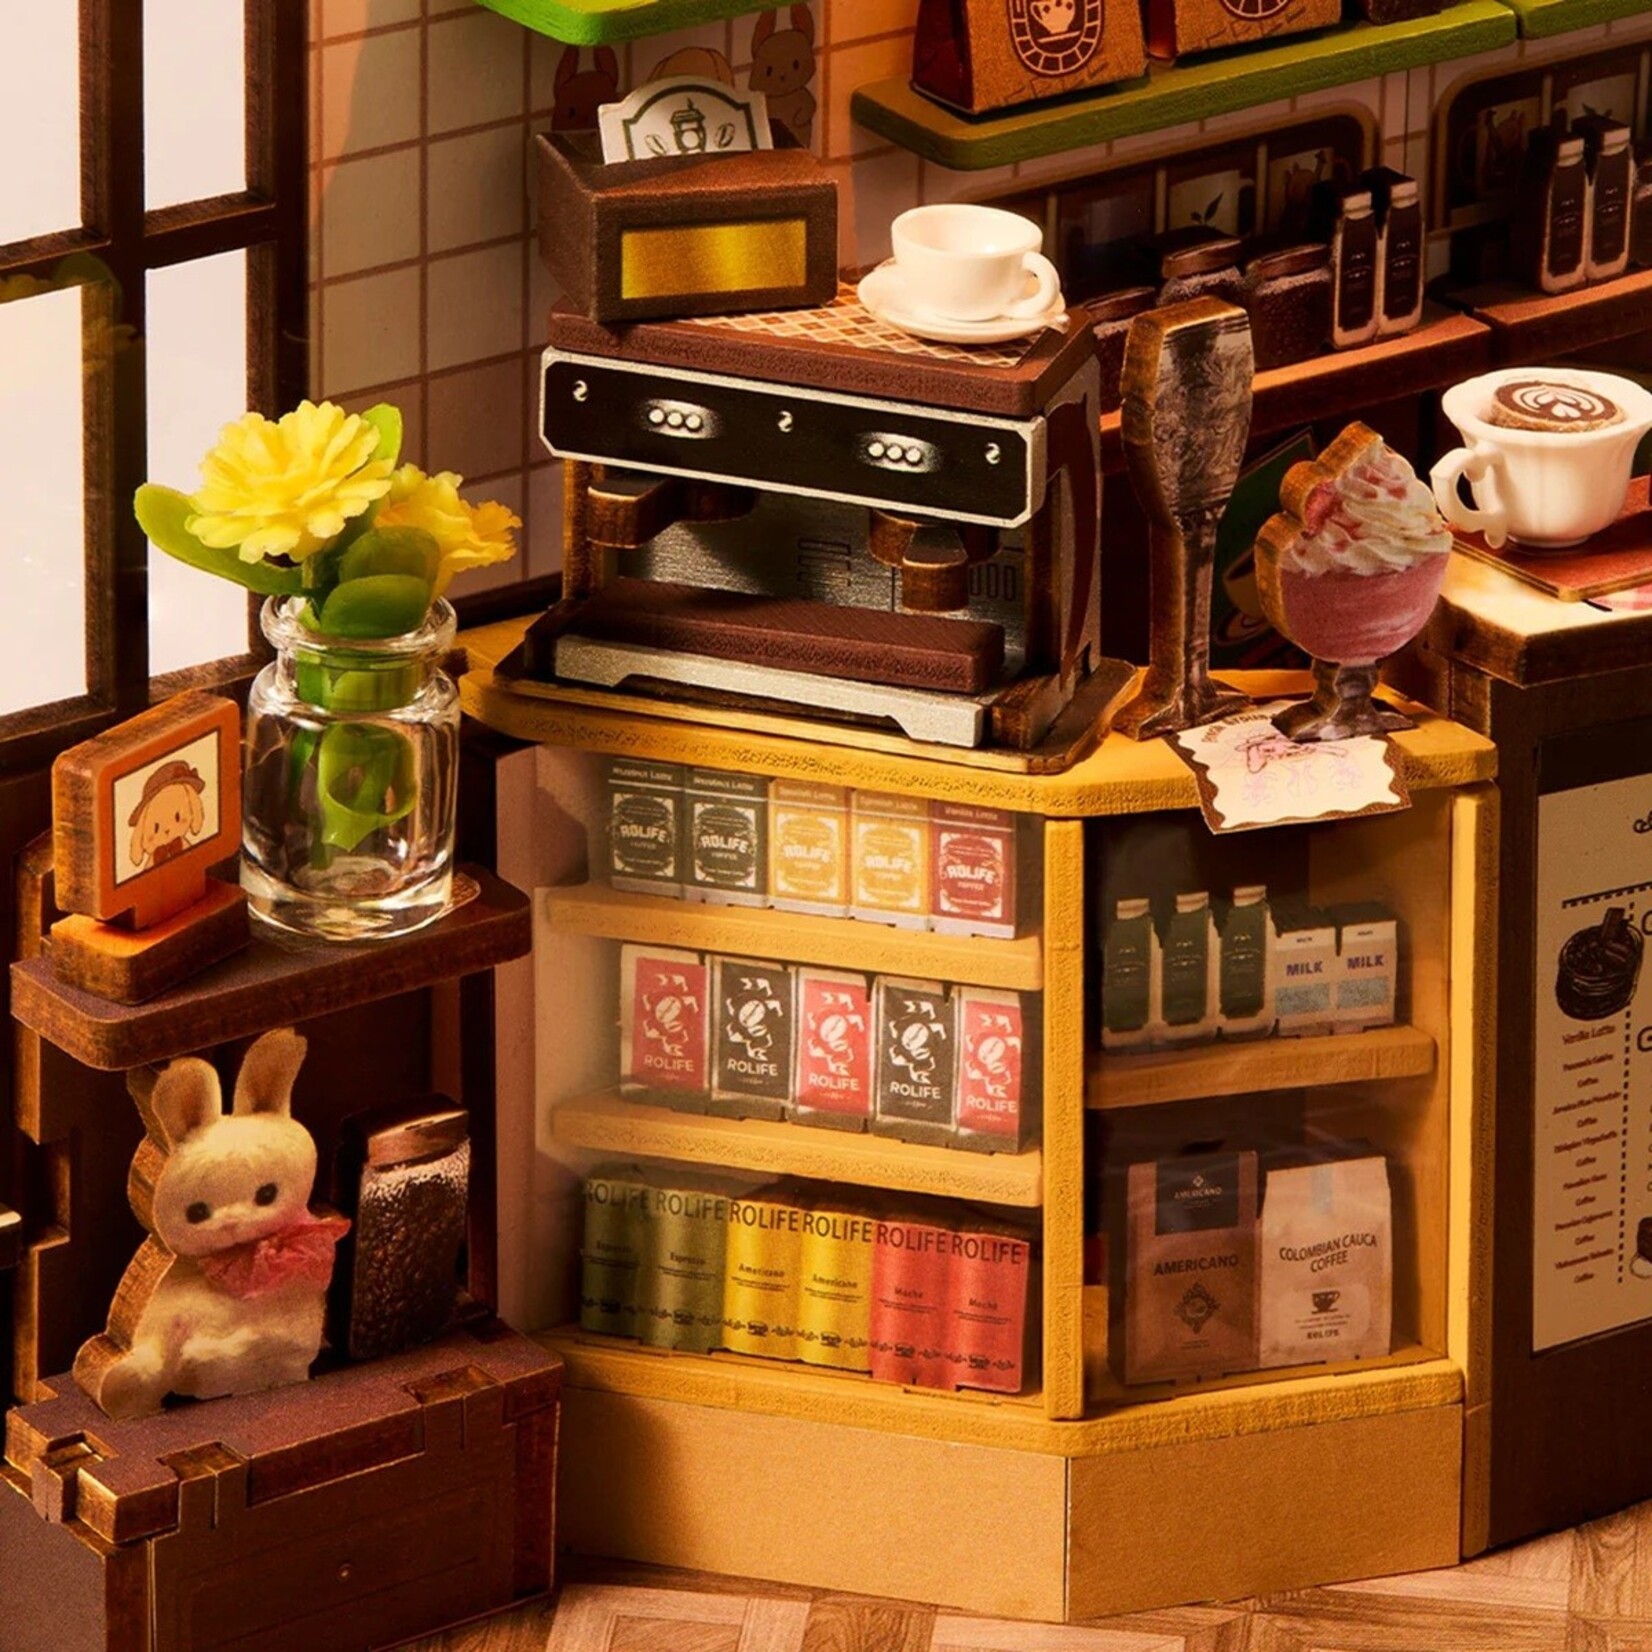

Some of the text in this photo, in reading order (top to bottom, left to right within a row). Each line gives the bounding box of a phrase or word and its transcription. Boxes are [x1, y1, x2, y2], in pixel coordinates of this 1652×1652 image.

[619, 824, 667, 842] ROLIFE
[701, 834, 750, 853] ROLIFE
[783, 844, 831, 864] ROLIFE
[864, 855, 913, 874] ROLIFE
[946, 864, 996, 885] ROLIFE
[1286, 960, 1323, 977] MILK
[1347, 954, 1384, 970] MILK
[644, 1053, 694, 1073] ROLIFE
[727, 1057, 778, 1077] ROLIFE
[808, 1072, 860, 1092] ROLIFE
[889, 1081, 941, 1100] ROLIFE
[966, 1094, 1018, 1114] ROLIFE
[656, 1191, 725, 1220] ROLIFE
[729, 1201, 798, 1232] ROLIFE
[802, 1212, 872, 1243] ROLIFE
[876, 1223, 947, 1254] ROLIFE
[1279, 1232, 1377, 1262] COLOMBIAN CAUCA
[951, 1234, 1021, 1265] ROLIFE
[738, 1263, 785, 1278] Americano
[1153, 1253, 1239, 1276] AMERICANO
[1310, 1249, 1349, 1273] COFFEE
[812, 1273, 858, 1289] Americano
